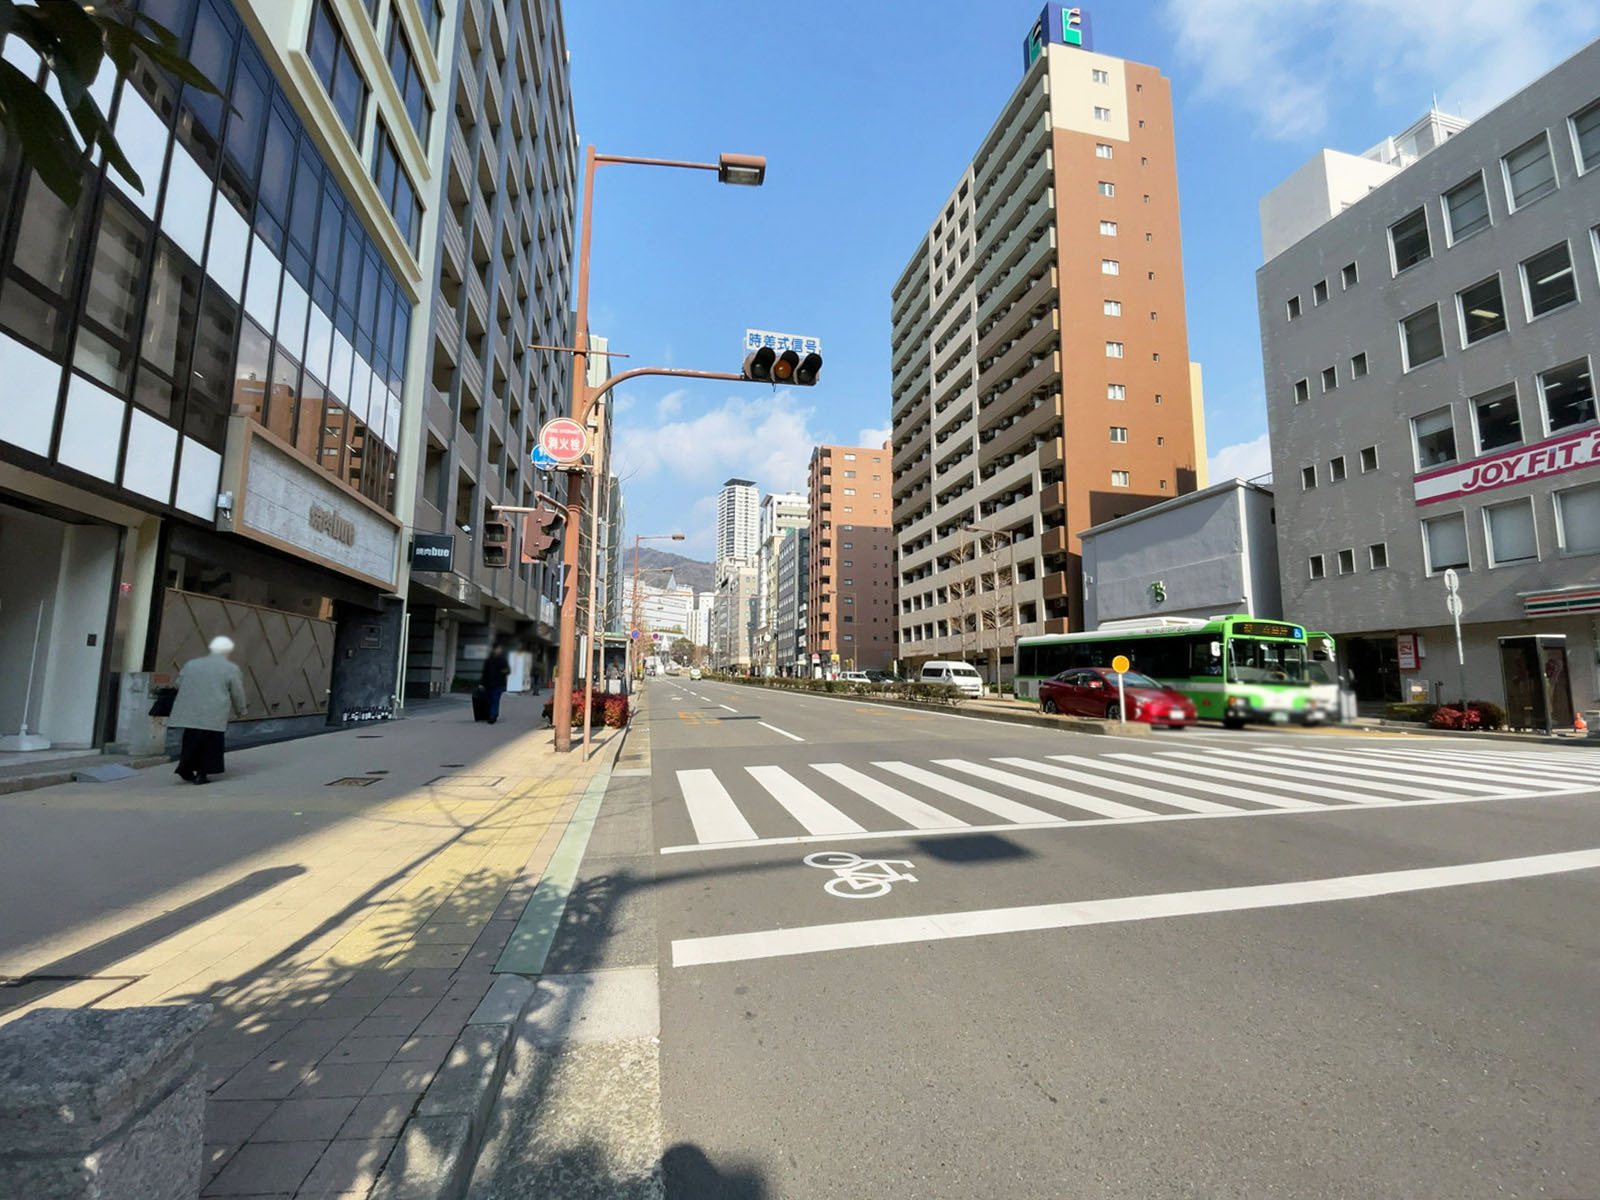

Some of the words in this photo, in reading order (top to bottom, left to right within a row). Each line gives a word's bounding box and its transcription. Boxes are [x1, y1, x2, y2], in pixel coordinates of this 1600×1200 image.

[749, 333, 817, 354] 時差式信号
[547, 436, 581, 451] 消火栓
